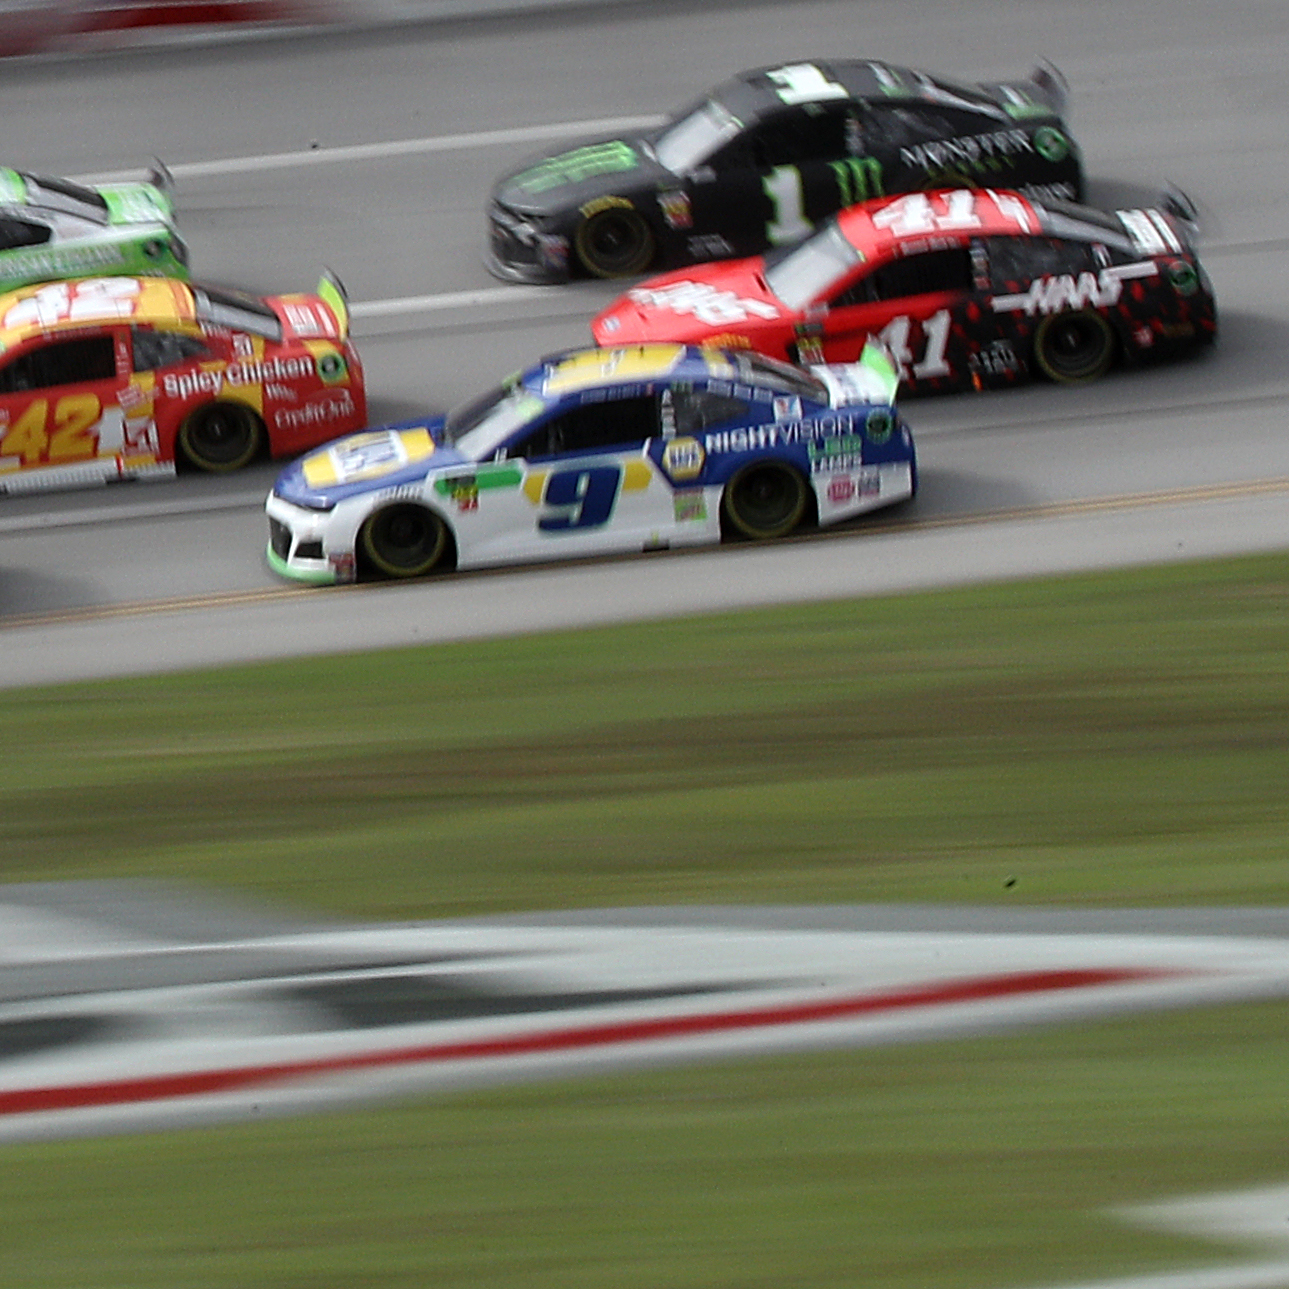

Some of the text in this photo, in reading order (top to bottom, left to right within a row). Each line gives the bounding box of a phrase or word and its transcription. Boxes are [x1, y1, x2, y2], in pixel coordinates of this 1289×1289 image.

[766, 64, 849, 105] 1
[762, 164, 815, 244] 1
[872, 189, 982, 238] 41
[164, 367, 224, 400] Spicy
[0, 392, 102, 464] 42
[538, 466, 622, 532] 9
